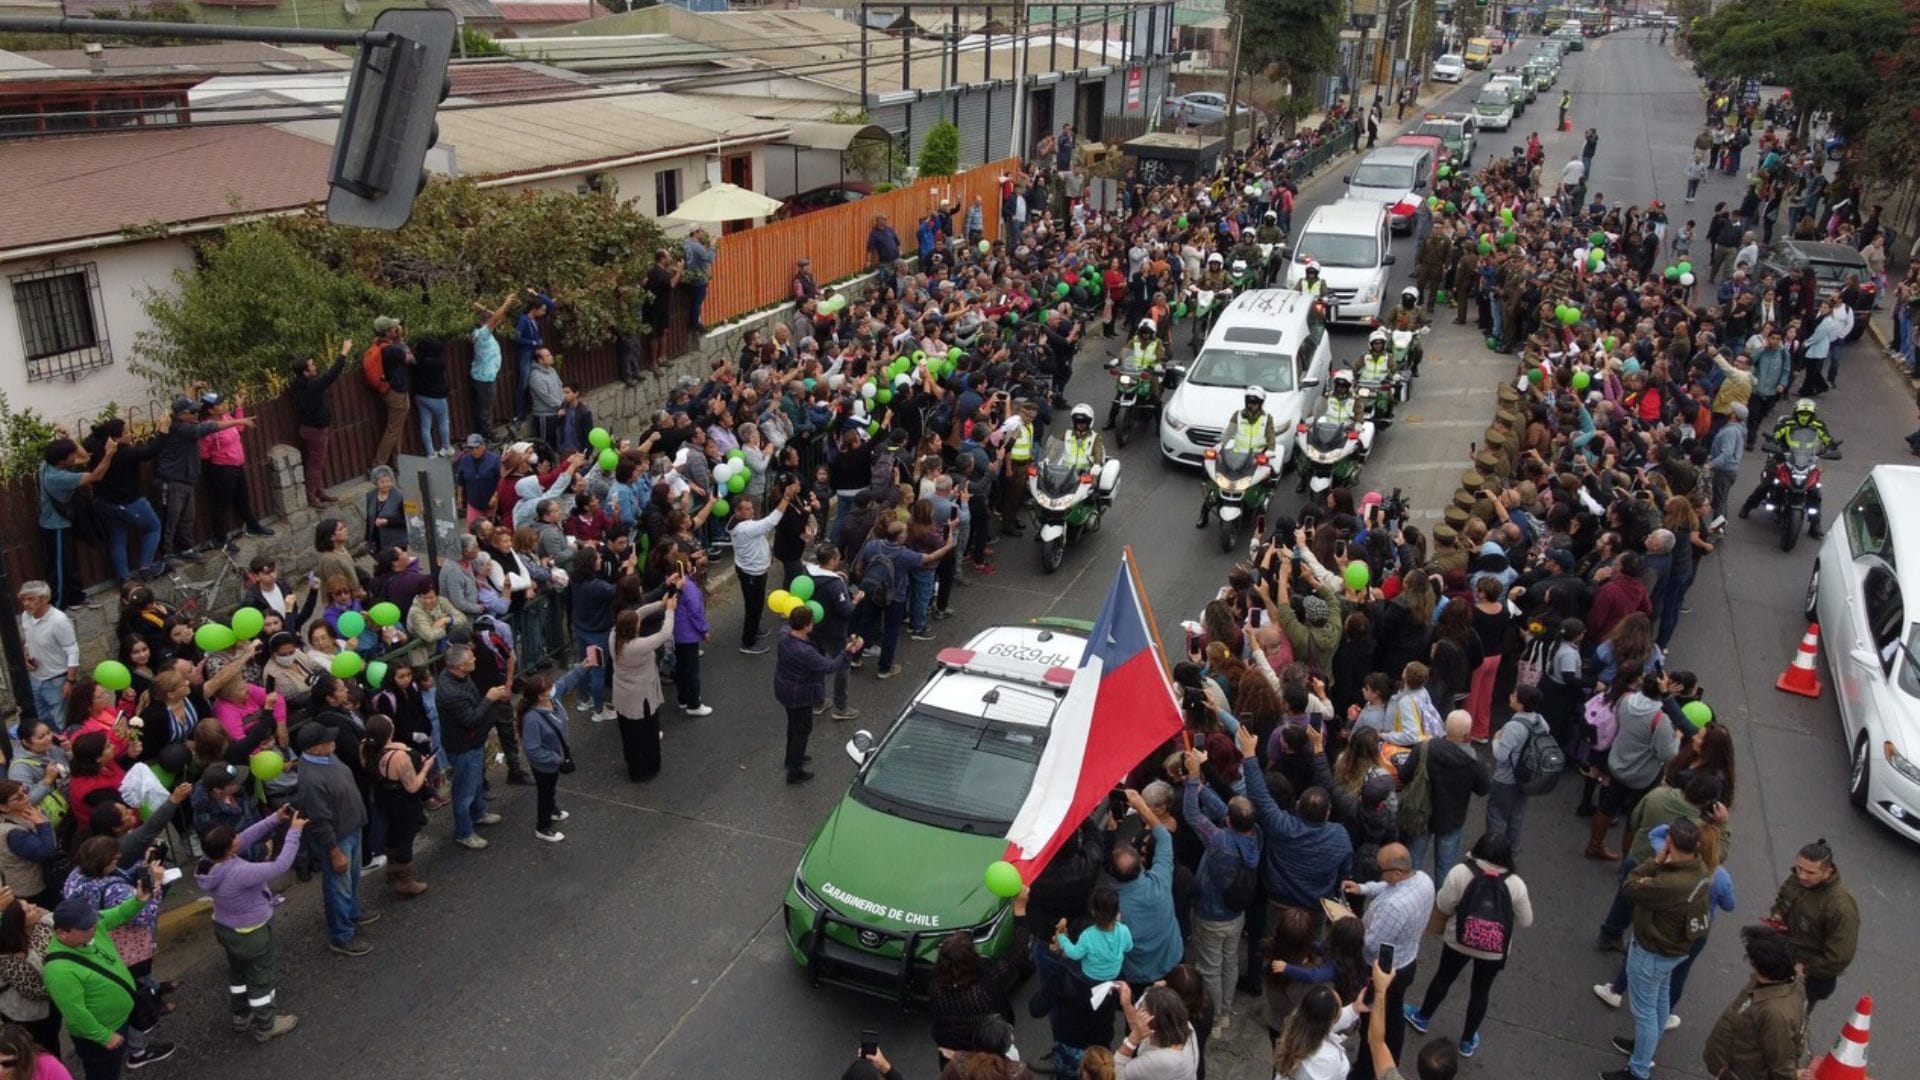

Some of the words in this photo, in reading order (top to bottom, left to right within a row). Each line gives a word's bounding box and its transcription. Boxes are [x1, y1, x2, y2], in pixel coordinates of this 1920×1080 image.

[988, 642, 1069, 666] RP6289
[821, 882, 887, 916] CARABINEROS
[887, 907, 904, 920] DE
[905, 912, 939, 927] CHILE
